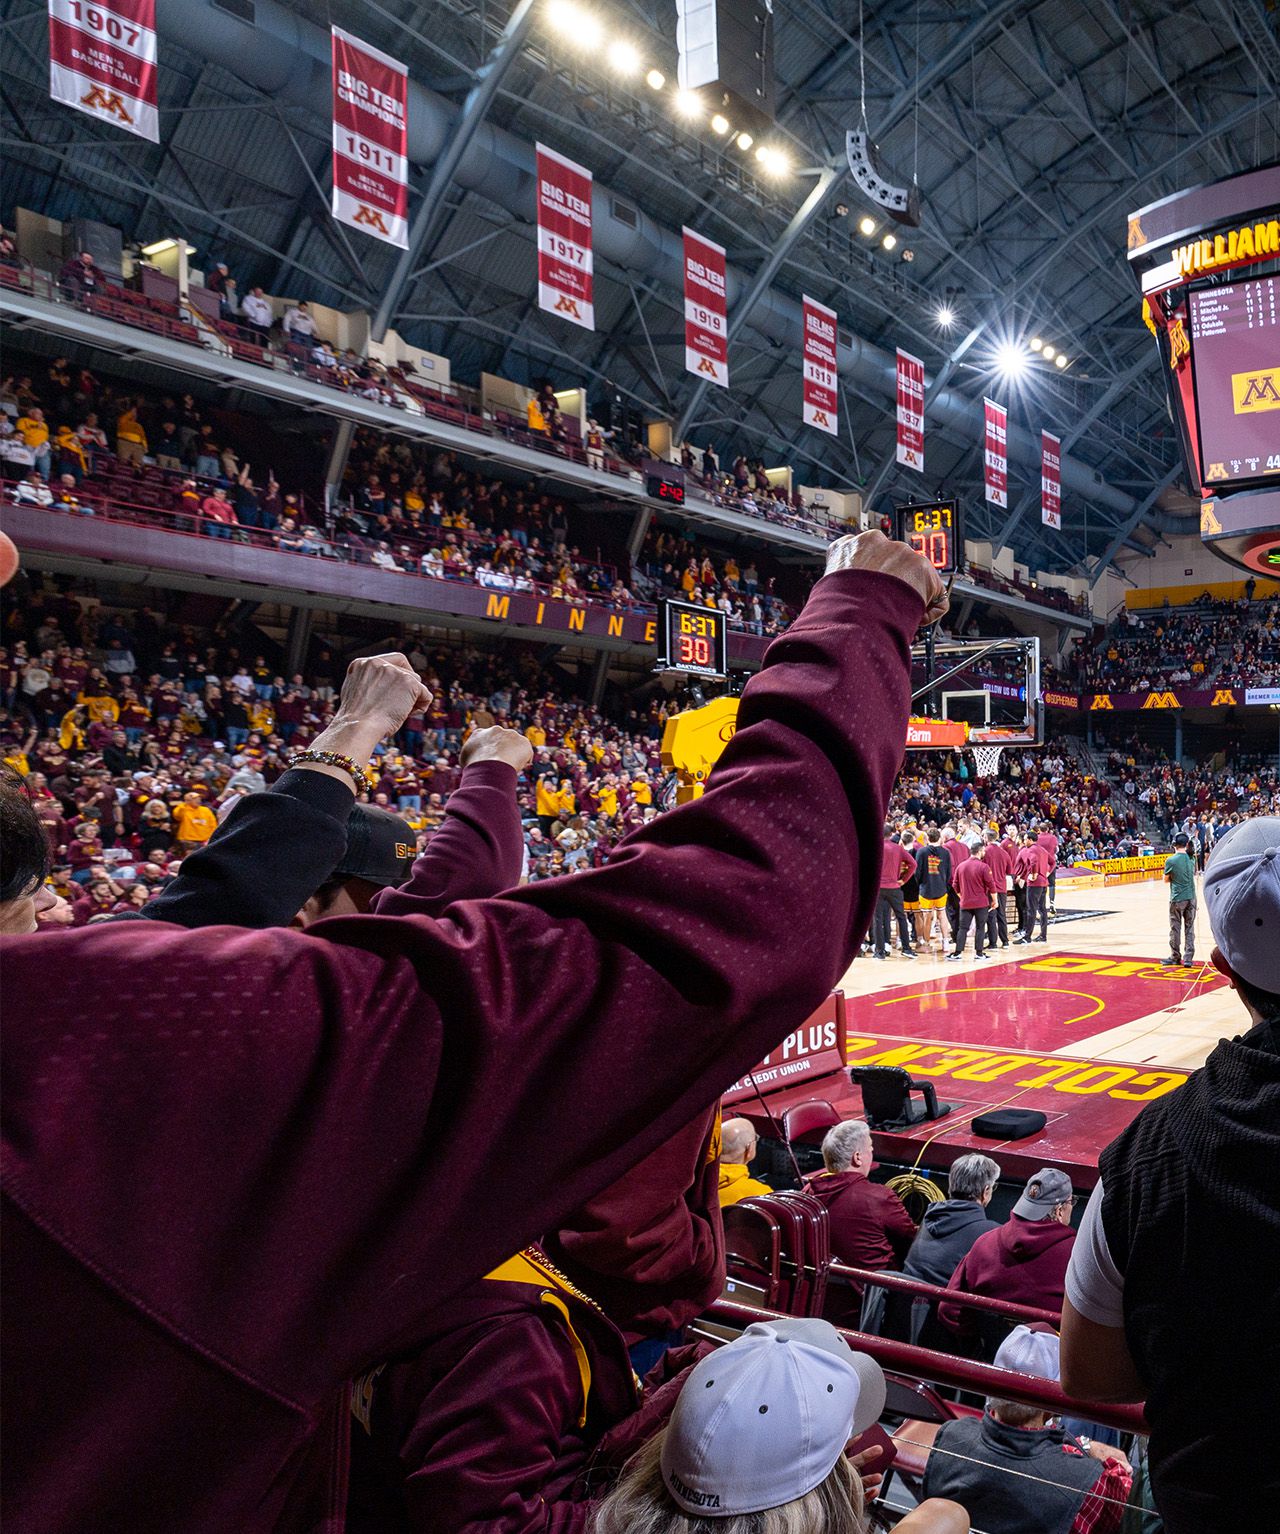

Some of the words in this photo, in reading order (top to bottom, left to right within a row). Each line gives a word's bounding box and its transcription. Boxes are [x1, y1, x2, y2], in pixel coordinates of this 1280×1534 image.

[68, 1, 139, 46] 1907
[71, 48, 141, 88] BASKETBALL
[338, 70, 369, 99] BIG
[371, 88, 403, 117] TEN
[338, 87, 405, 130] CHAMPIONS
[346, 137, 393, 173] 1911
[541, 180, 563, 202] BIG
[565, 192, 590, 217] TEN
[549, 237, 584, 264] 1917
[1198, 287, 1234, 300] MINNESOTA
[693, 307, 721, 329] 1919
[809, 366, 831, 385] 1919
[1266, 455, 1280, 468] 44
[914, 509, 951, 532] 6:37
[680, 613, 715, 637] 6:37
[679, 636, 709, 664] 30
[676, 662, 717, 674] DAKTRONICS
[984, 683, 1002, 694] FOLLOW
[1003, 687, 1009, 695] US
[1010, 688, 1018, 697] ON
[906, 727, 931, 742] Farm
[783, 1021, 836, 1059] PLUS
[780, 1060, 811, 1076] UNION
[669, 1468, 721, 1508] MINNESOTA
